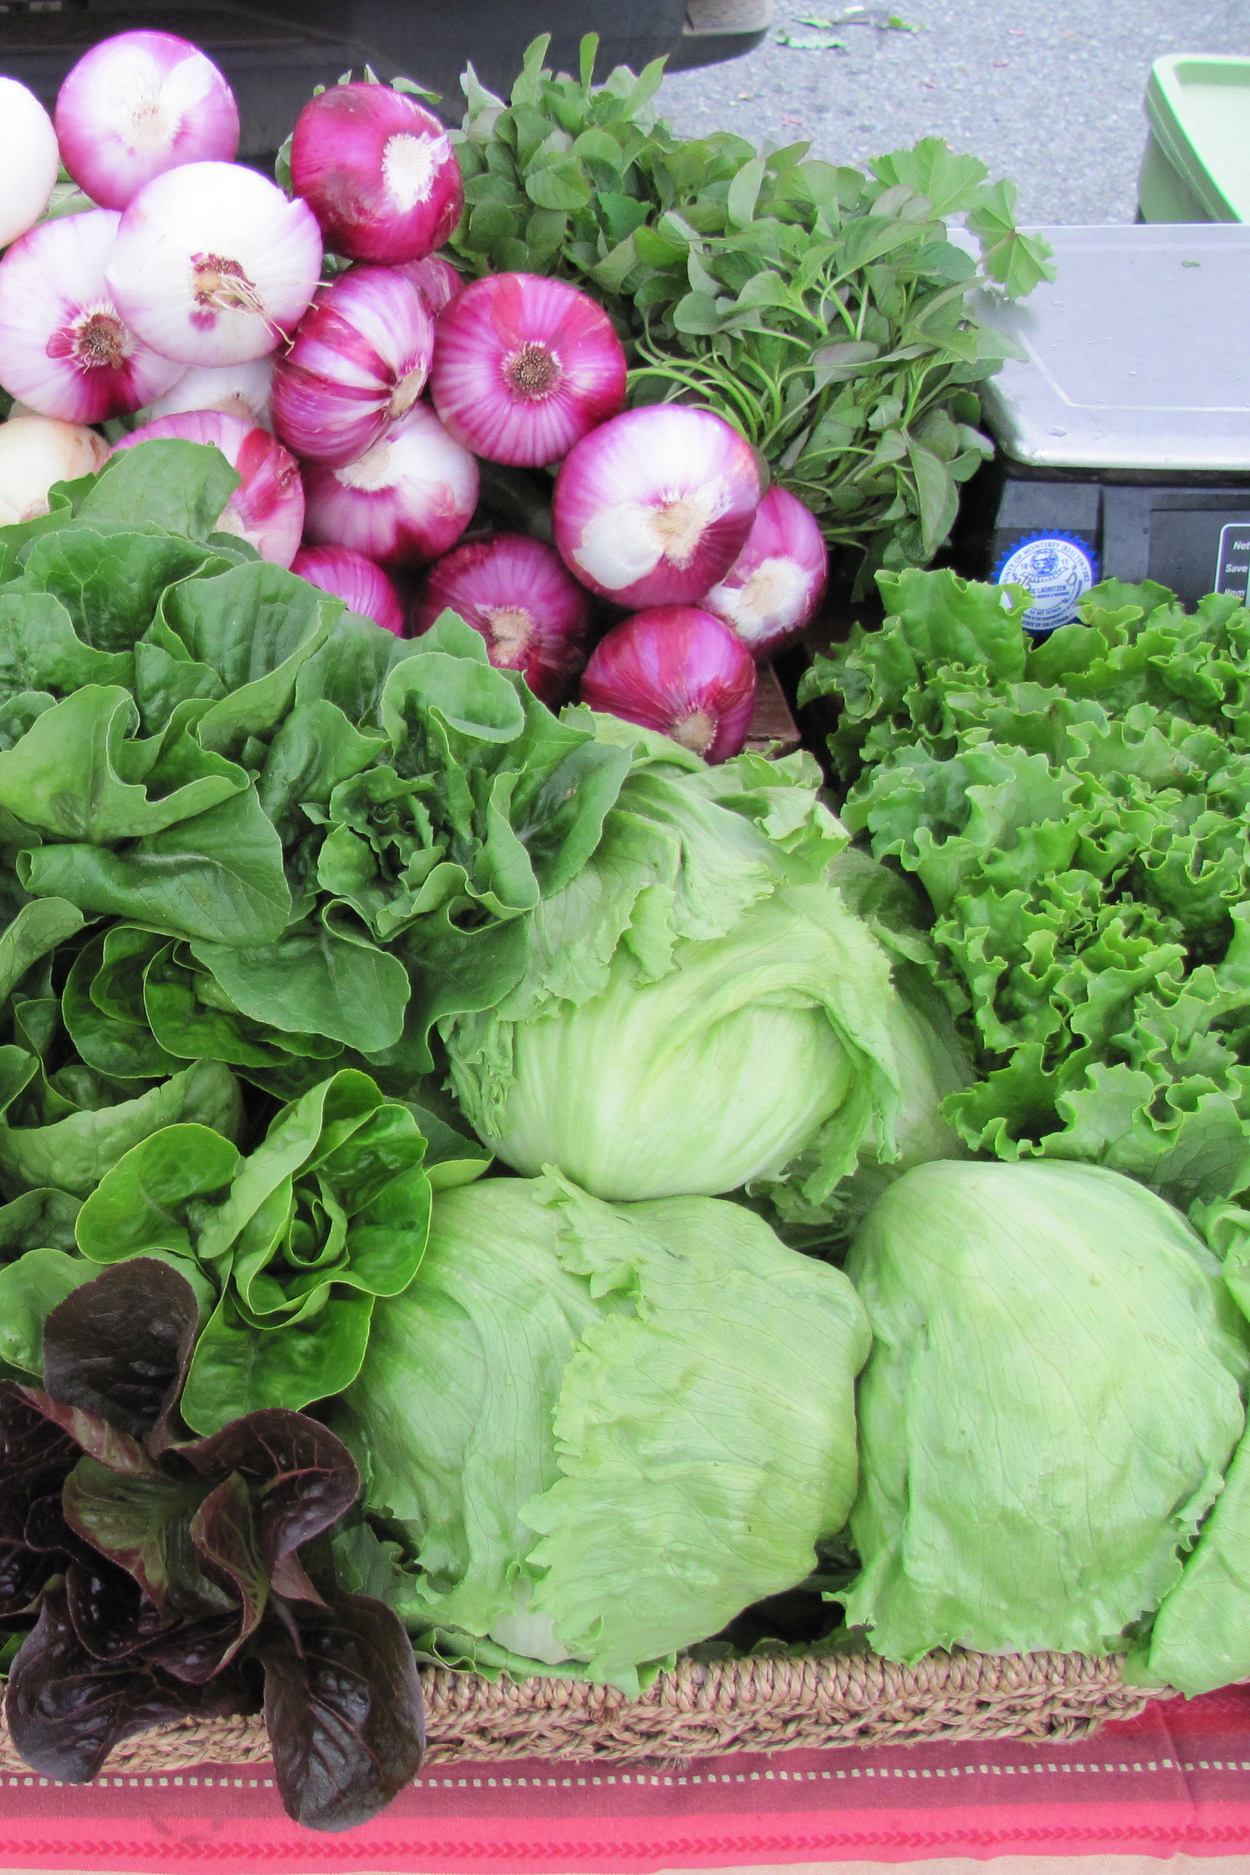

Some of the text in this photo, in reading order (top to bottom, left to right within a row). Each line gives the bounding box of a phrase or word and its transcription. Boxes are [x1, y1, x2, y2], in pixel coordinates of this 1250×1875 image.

[1233, 541, 1250, 550] Net
[1013, 554, 1023, 564] OF
[1023, 541, 1060, 554] MONTEREY
[1225, 563, 1248, 573] Save
